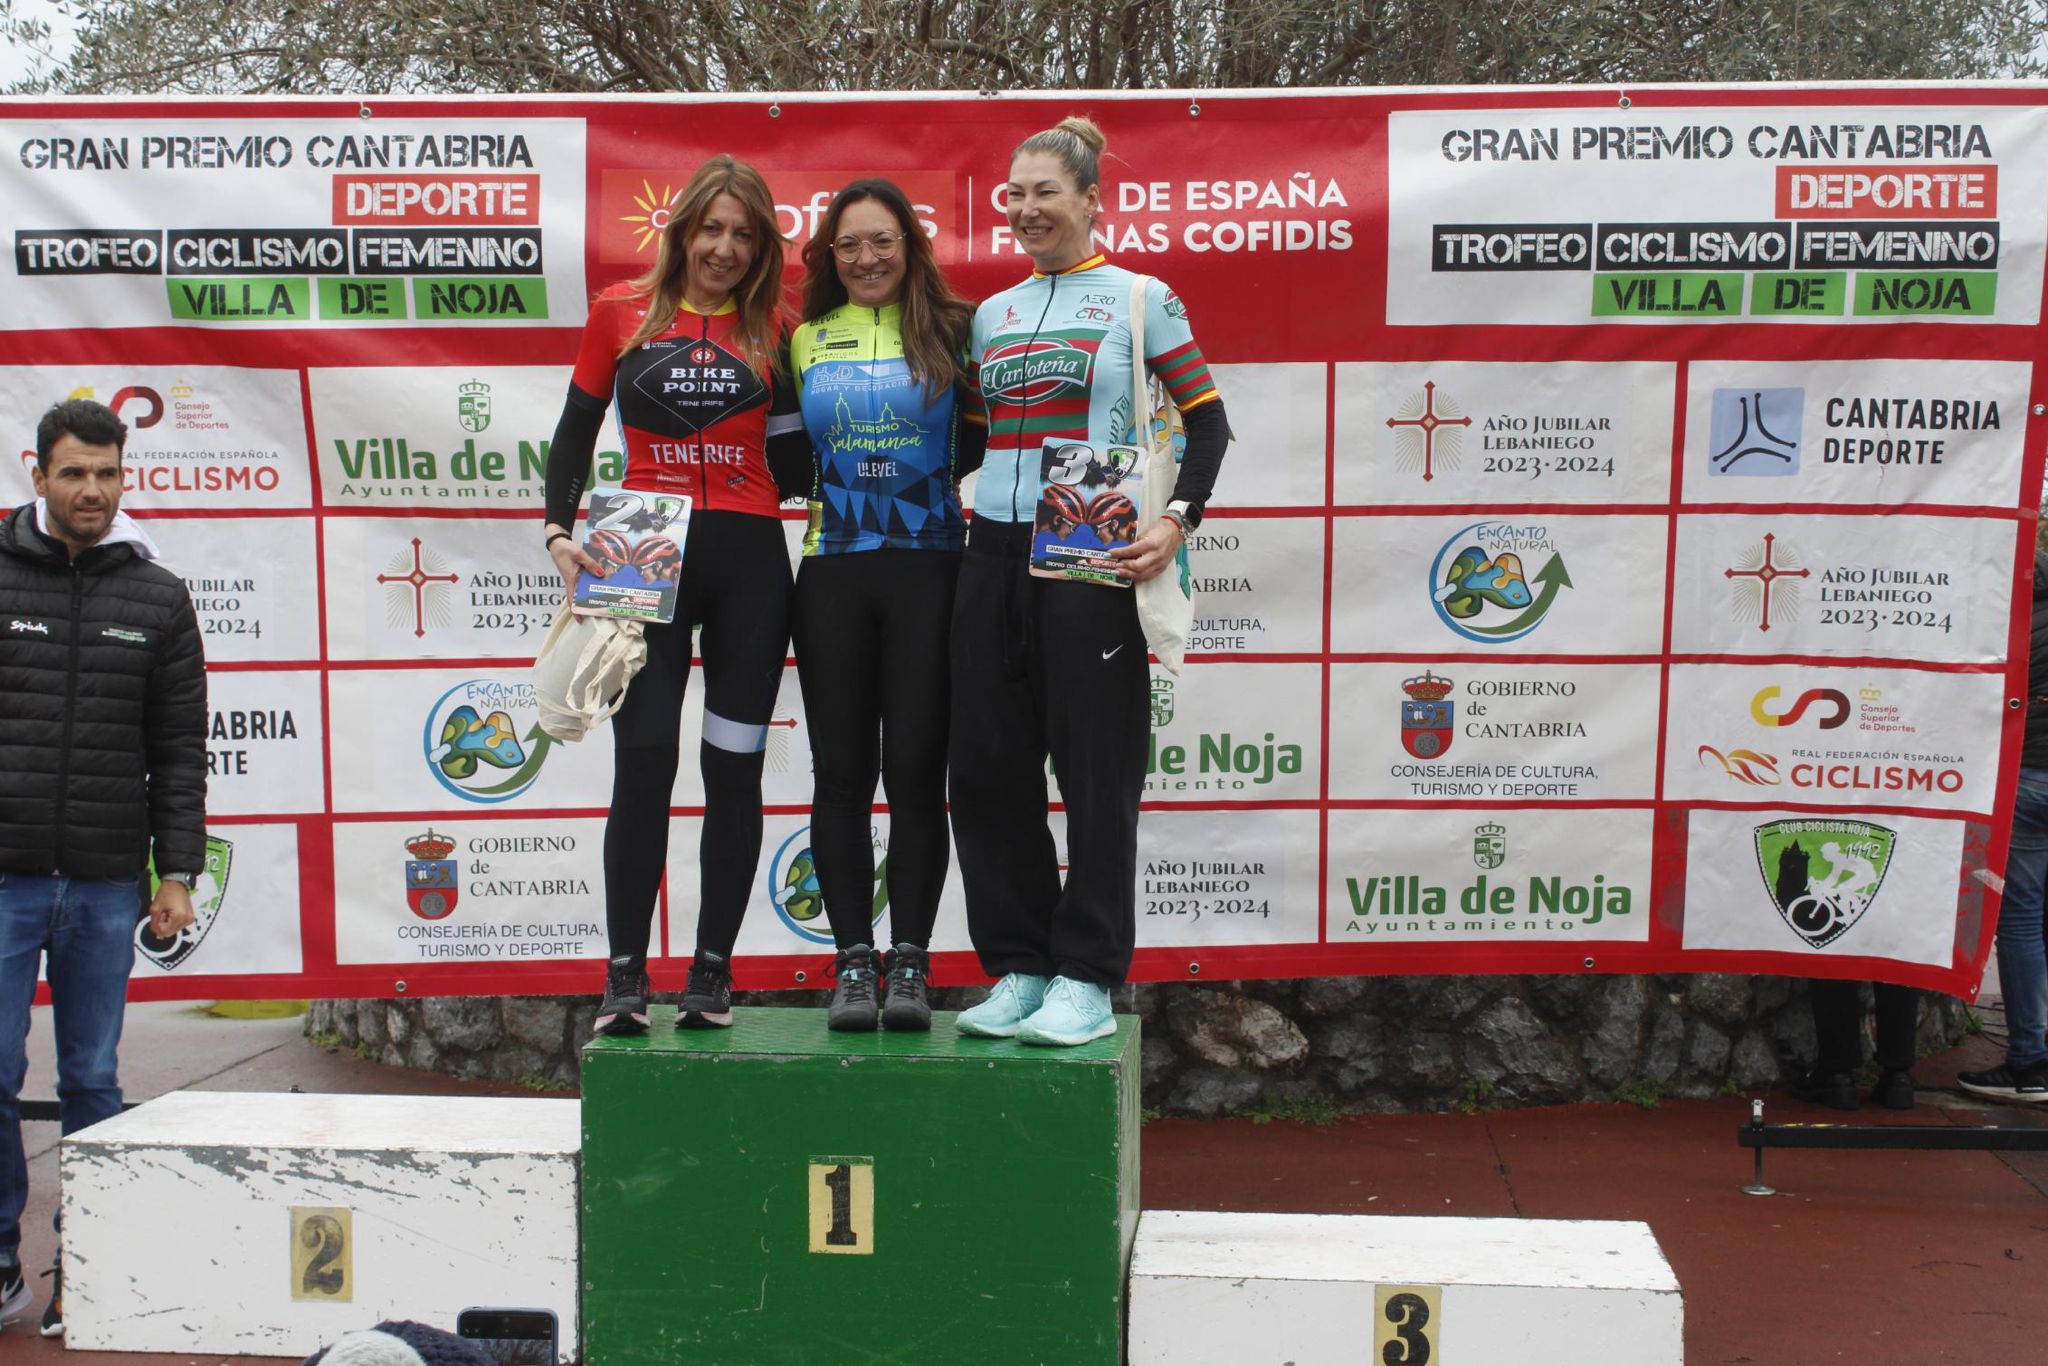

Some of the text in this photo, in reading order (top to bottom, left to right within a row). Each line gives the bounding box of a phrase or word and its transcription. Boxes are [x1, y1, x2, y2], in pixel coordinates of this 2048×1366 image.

[1441, 124, 1992, 161] GRAN PREMIO CANTABRIA
[20, 135, 534, 169] GRAN PREMIO CANTABRIA
[347, 182, 528, 217] DEPORTE
[1119, 181, 1171, 212] DE
[1186, 171, 1348, 211] ESPAÑA
[1791, 173, 1985, 209] DEPORTE
[1183, 219, 1353, 253] COFIDIS
[20, 236, 539, 269] TROFEO CICLISMO FEMENINO
[1439, 230, 1995, 264] TROFEO CICLISMO FEMENINO
[183, 283, 527, 316] VILLA DE NOJA
[1080, 294, 1116, 305] AERO
[1610, 277, 1971, 312] VILLA DE NOJA
[670, 367, 736, 379] BIKE
[662, 381, 741, 394] POINT
[174, 402, 210, 412] Consejo
[1826, 397, 2000, 430] CANTABRIA
[175, 411, 213, 421] Superior
[176, 421, 230, 430] de Deportes
[850, 422, 899, 433] TURISMO
[828, 434, 922, 454] Salamanca
[1823, 438, 1945, 464] DEPORTE
[144, 450, 215, 459] FEDERACIÓN
[220, 450, 279, 459] ESPAÑOLA
[335, 438, 437, 481] Villa
[451, 438, 506, 481] de
[649, 443, 745, 466] TENERIFE
[1048, 444, 1094, 486] 3
[122, 466, 280, 492] CICLISMO
[340, 484, 546, 498] Ayuntamient
[594, 493, 644, 533] 2
[1477, 525, 1546, 542] ENCANTO
[1489, 537, 1558, 552] NATURAL
[516, 574, 566, 590] JUBIL
[1191, 578, 1253, 592] ABRIA
[470, 591, 567, 607] LEBANIEG
[1467, 680, 1576, 696] GOBIERNO
[480, 696, 538, 710] NATURA
[1467, 702, 1487, 716] de
[1860, 704, 1898, 714] Consejo
[207, 710, 297, 740] ABRIA
[1861, 713, 1900, 723] Superior
[1465, 722, 1586, 738] CANTABRIA
[1860, 722, 1916, 733] de Deportes
[1199, 733, 1302, 784] Noja
[1792, 749, 1965, 763] REAL FEDERACIÓN ESPAÑOLA
[1391, 763, 1599, 780] CONSEJERÍA DE CULTURA,
[1790, 764, 1963, 793] CICLISMO
[1411, 783, 1578, 796] TURISMO Y DEPORTE
[1780, 821, 1870, 837] CLUB CICLISTA NOJA
[469, 836, 576, 853] GOBIERNO
[470, 859, 490, 874] de
[470, 880, 590, 897] CANTABRIA
[1346, 874, 1632, 924] Villa de Noja
[397, 923, 603, 939] CONSEJERÍA DE CULTURA,
[1346, 918, 1574, 933] Ayuntamiento
[418, 942, 585, 958] TURISMO Y DEPORTE
[825, 1163, 858, 1246] 1
[300, 1214, 344, 1296] 2
[1382, 1292, 1430, 1366] 3
